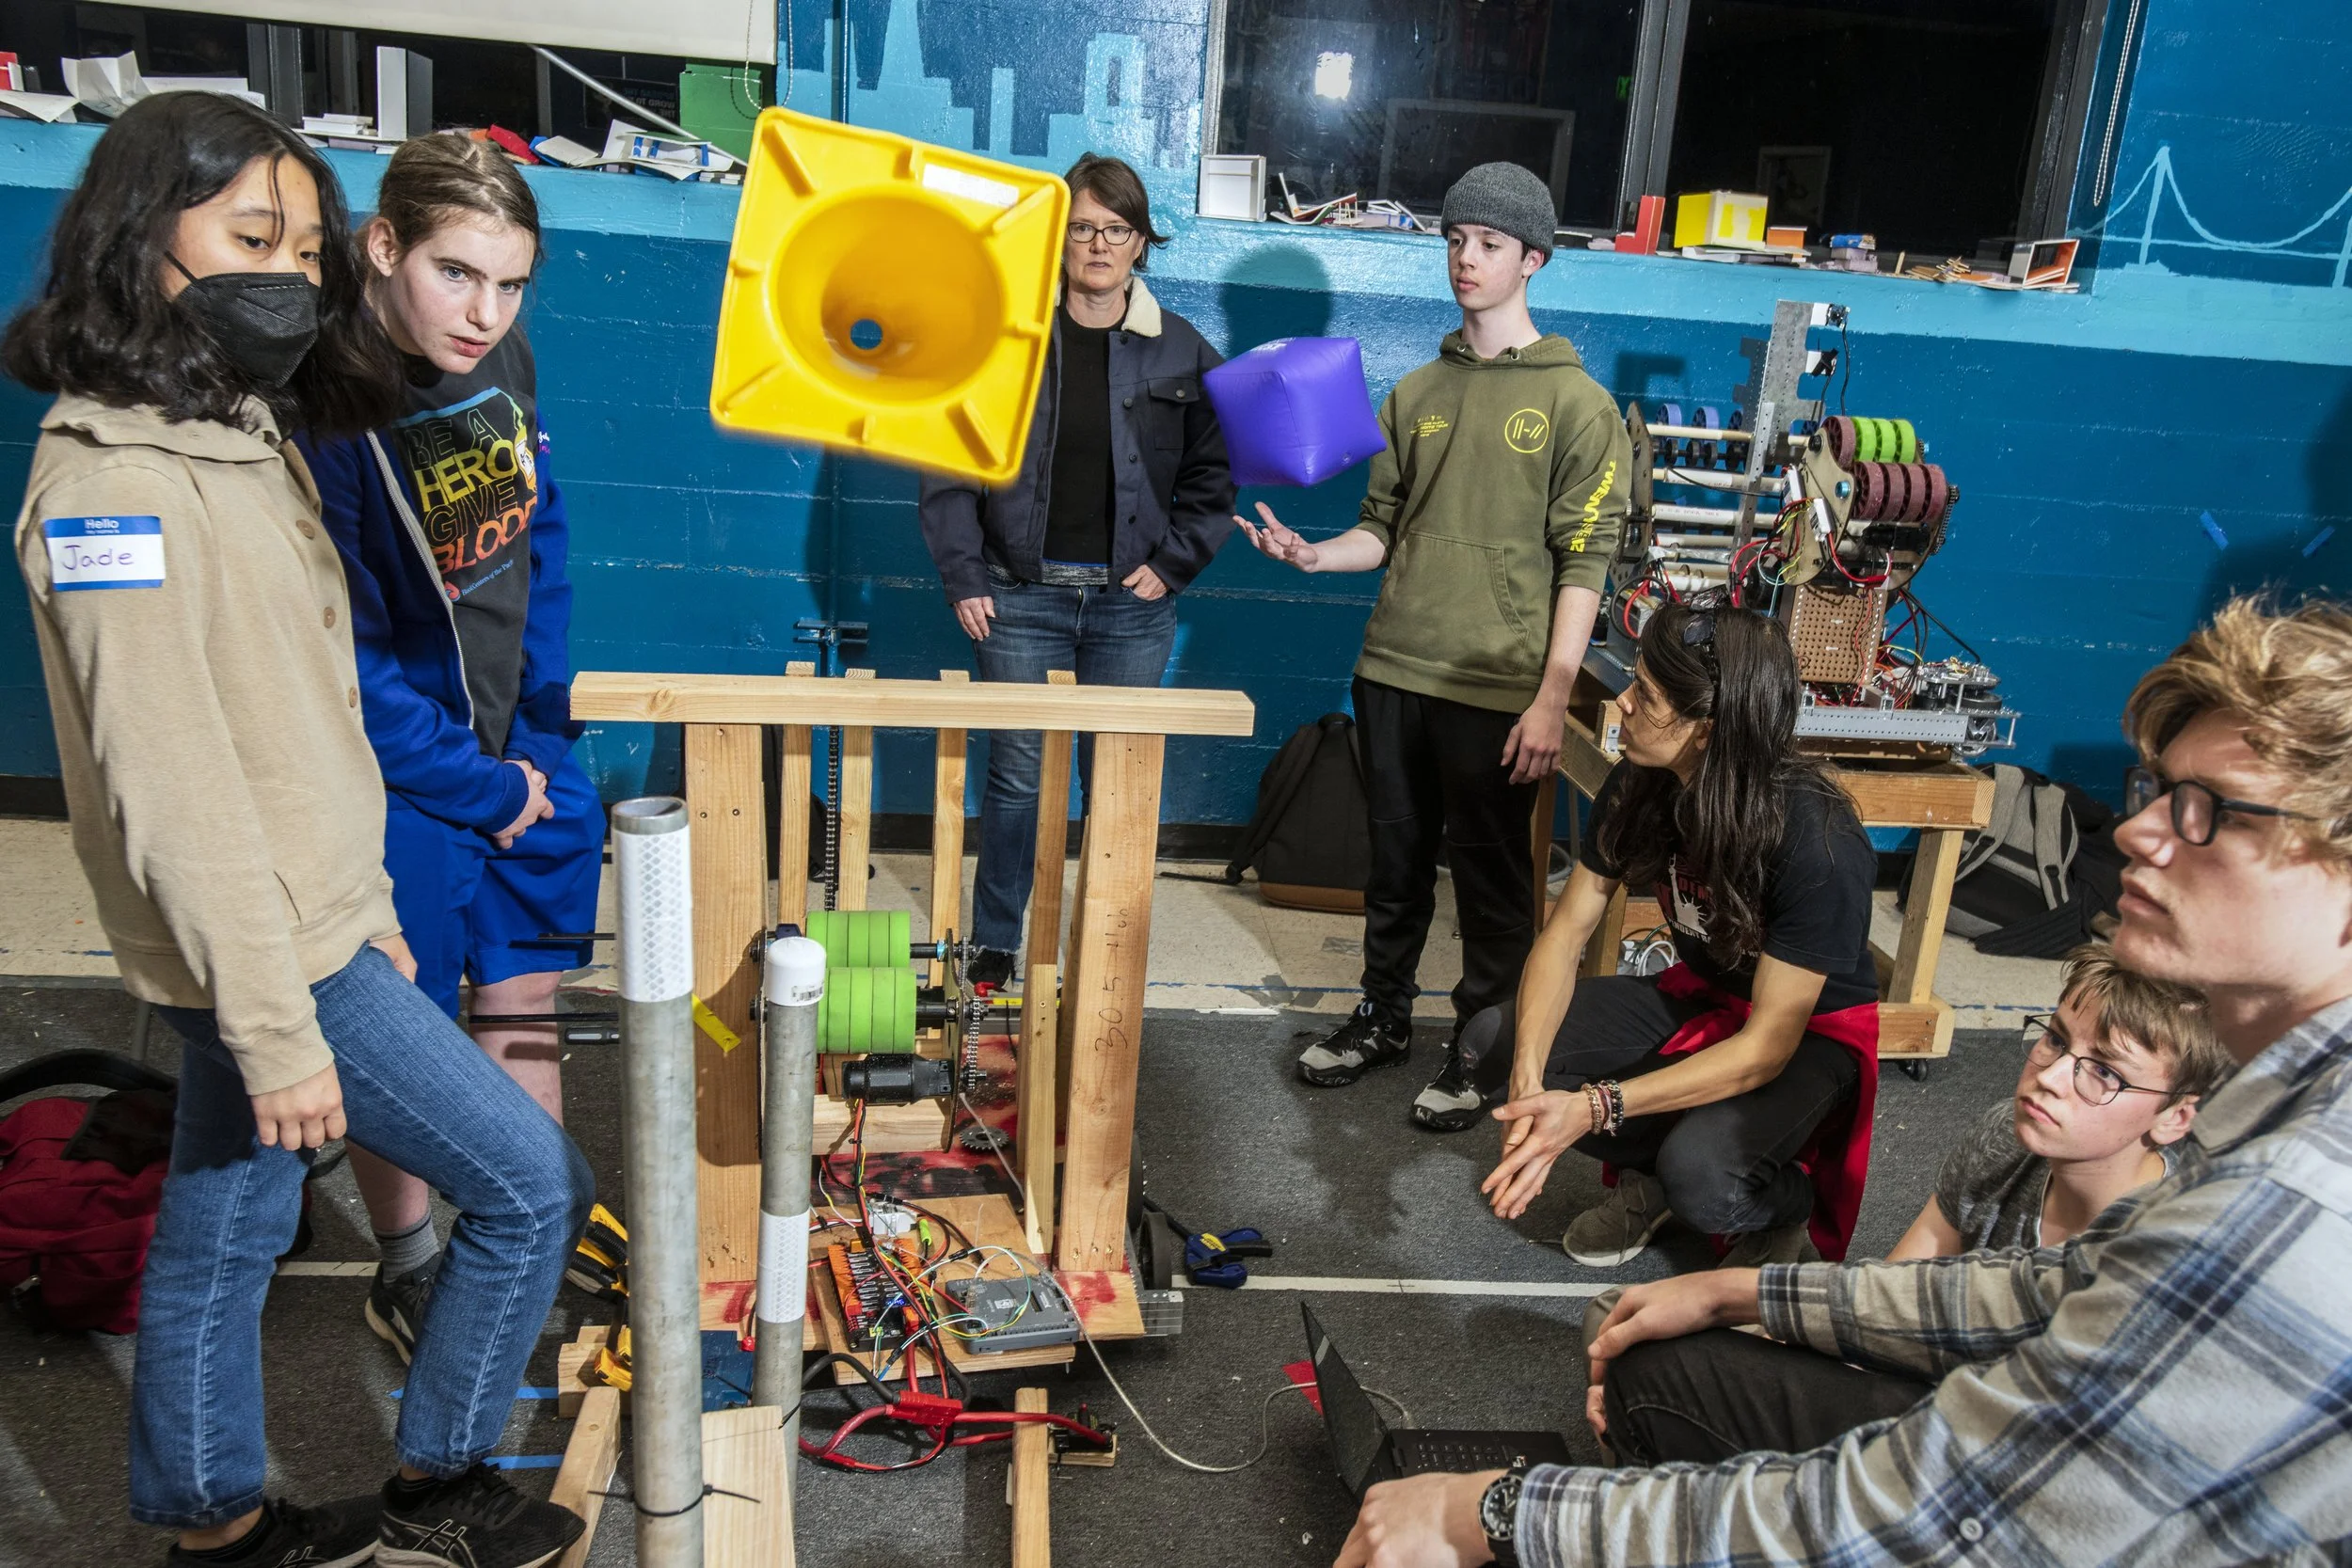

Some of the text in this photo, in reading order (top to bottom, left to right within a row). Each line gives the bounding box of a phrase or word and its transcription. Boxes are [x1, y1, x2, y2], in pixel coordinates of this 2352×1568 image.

[405, 419, 456, 471] BE
[468, 408, 503, 451] A
[414, 439, 517, 512] HERO
[84, 518, 119, 530] Hello
[423, 478, 518, 547] GIVE
[61, 545, 135, 571] Jade
